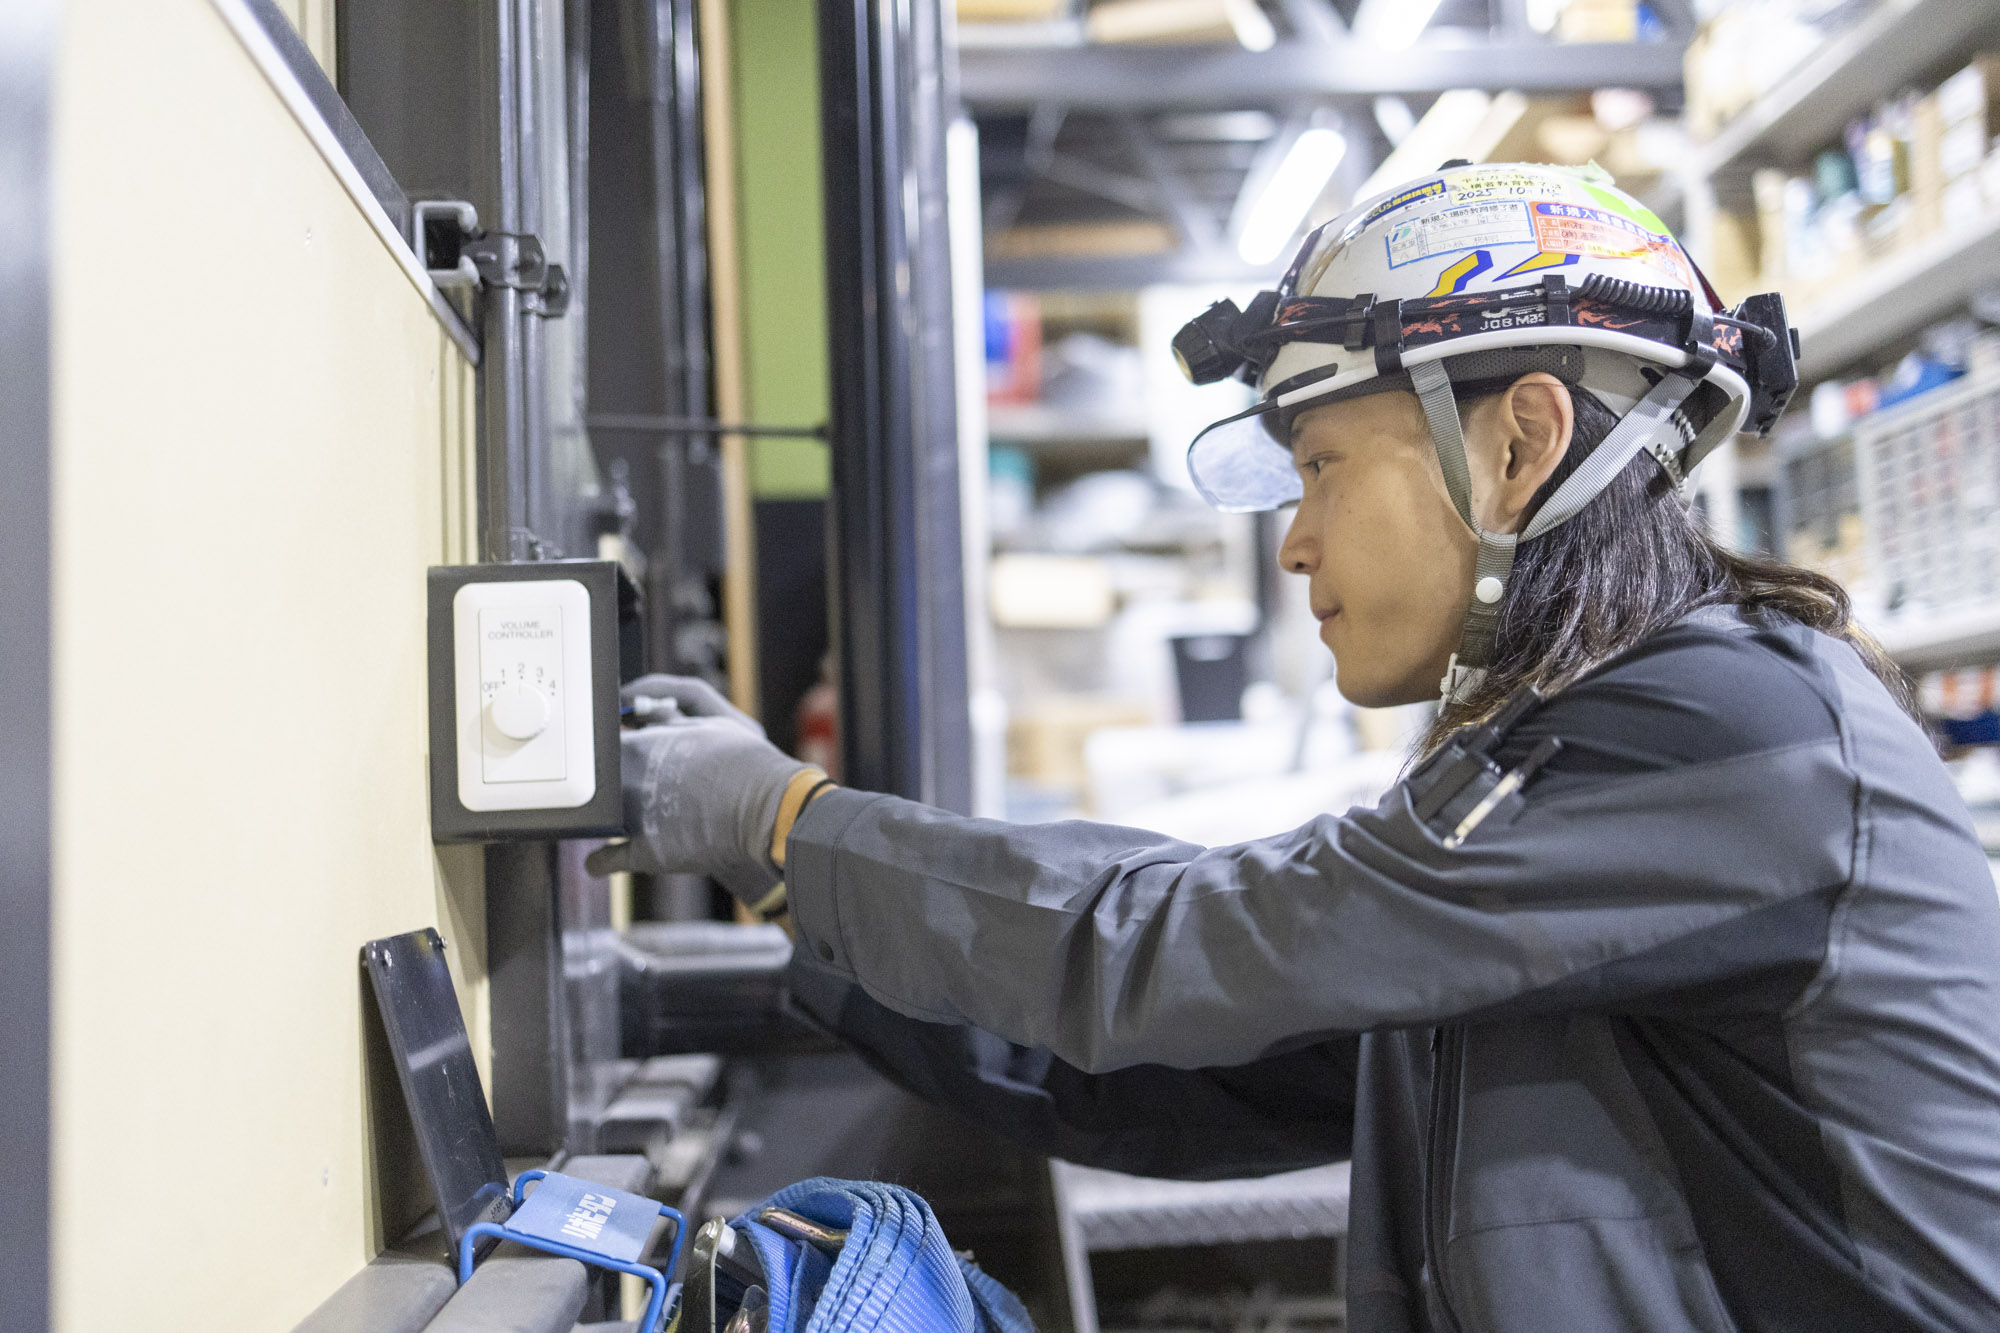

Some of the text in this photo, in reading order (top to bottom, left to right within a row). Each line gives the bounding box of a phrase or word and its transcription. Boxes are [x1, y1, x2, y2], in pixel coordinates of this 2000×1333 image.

[1458, 188, 1497, 201] 2025
[1480, 318, 1512, 331] JOB
[501, 621, 541, 629] VOLUME
[488, 629, 554, 640] CONTROLLER
[517, 663, 525, 674] 2
[536, 667, 544, 677] 3
[482, 681, 500, 692] OFF
[549, 680, 556, 689] 4
